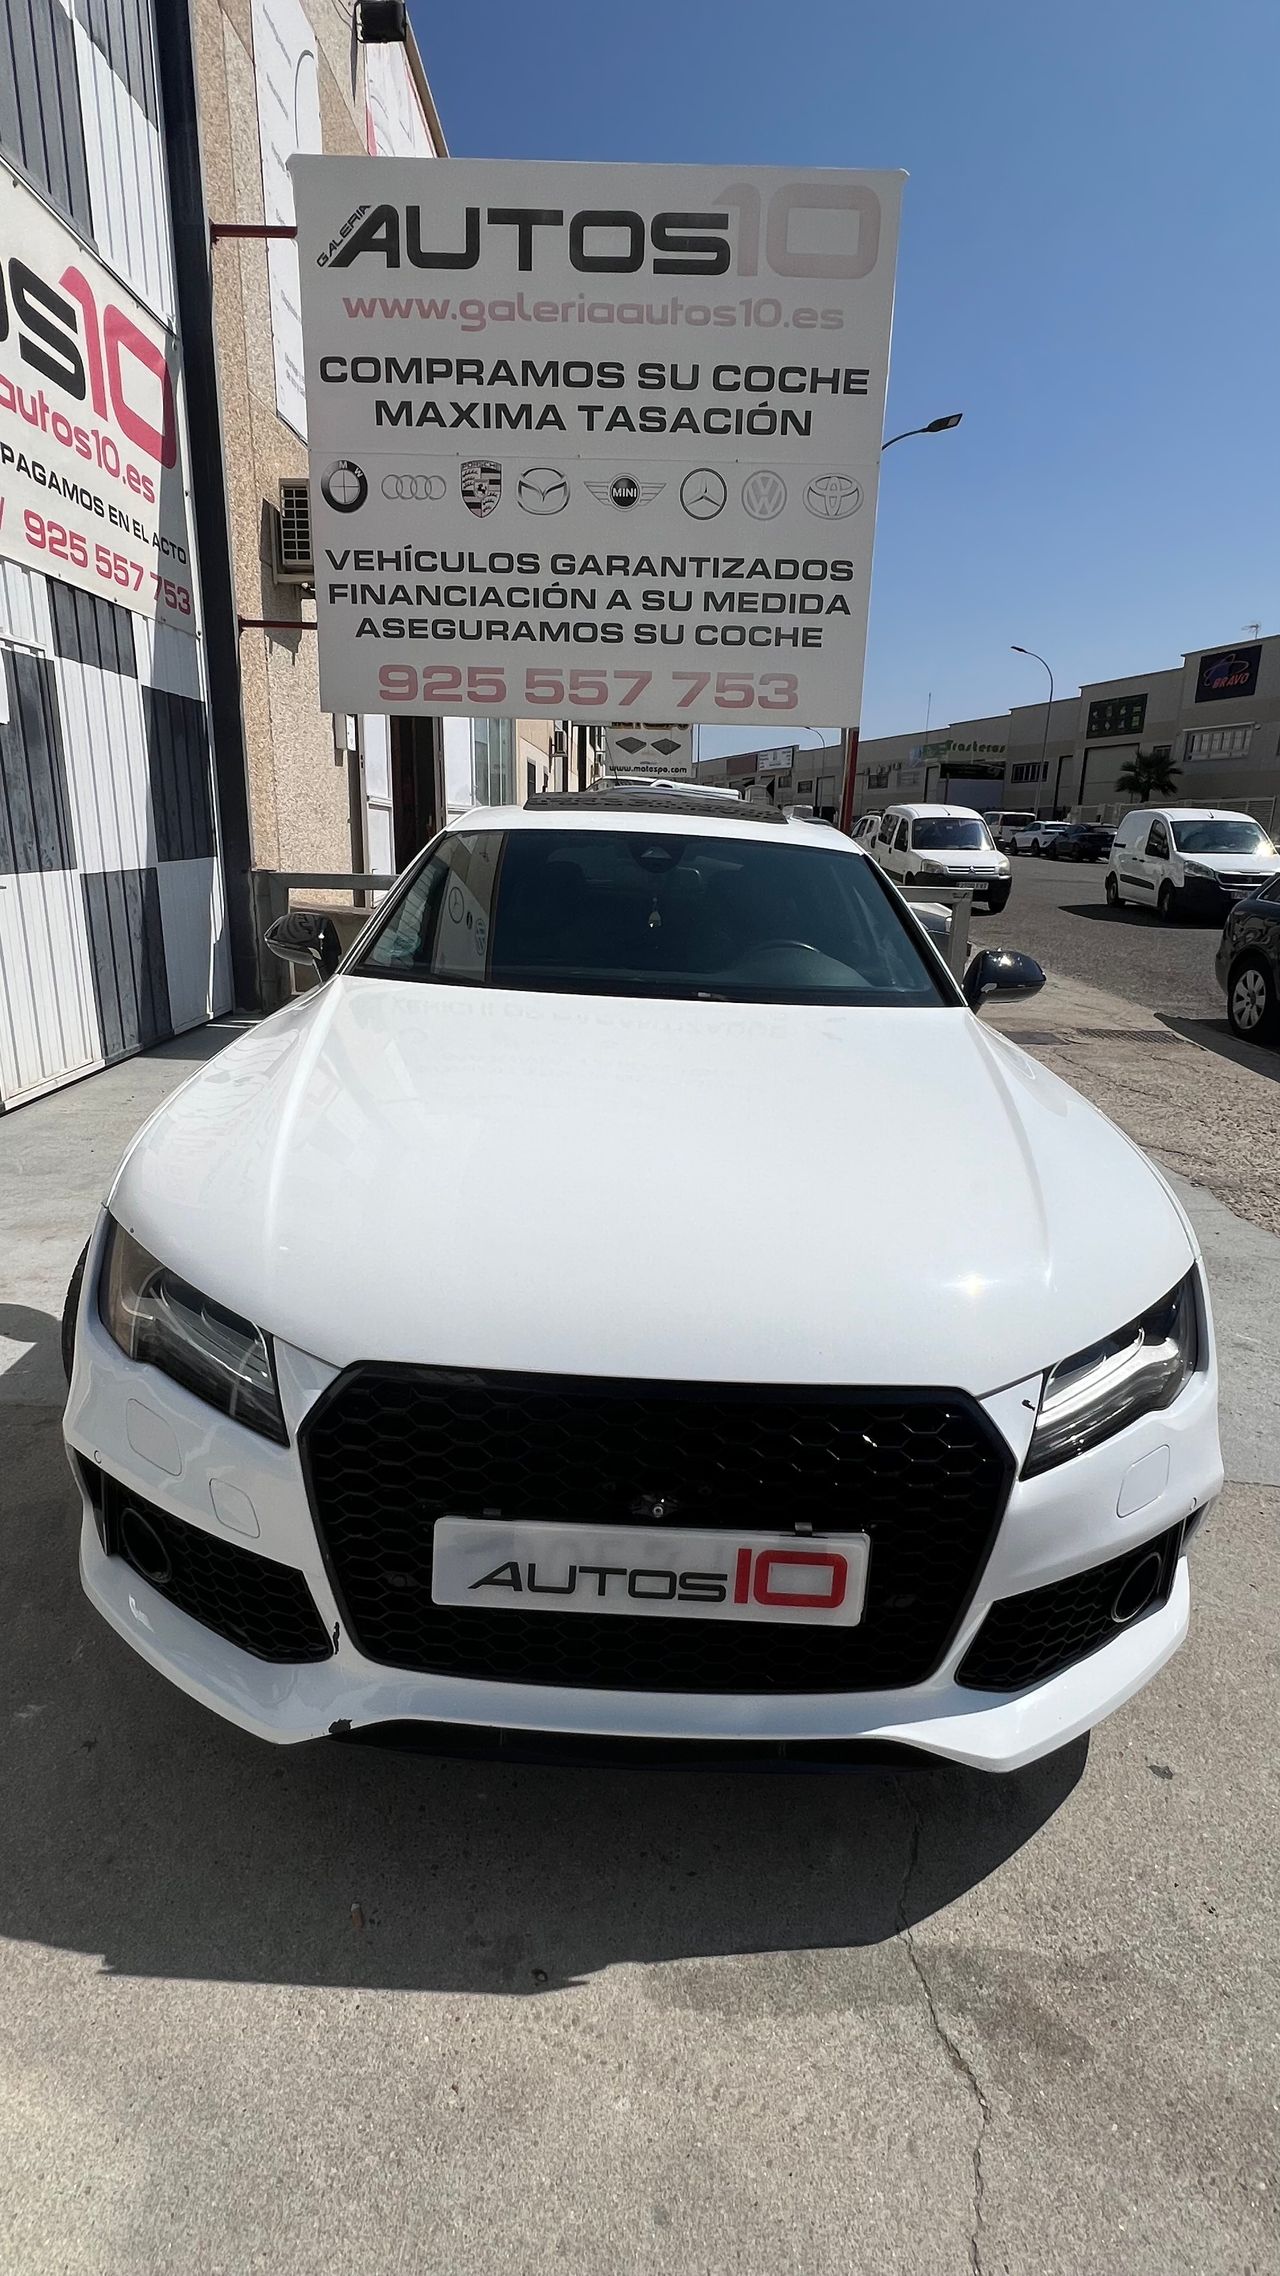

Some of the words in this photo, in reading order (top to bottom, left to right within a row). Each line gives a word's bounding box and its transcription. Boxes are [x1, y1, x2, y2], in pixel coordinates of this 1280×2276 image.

[316, 204, 371, 267] GALERIA
[342, 292, 844, 332] www.galeriaautos10.es
[0, 256, 177, 469] S10
[319, 355, 625, 389] COMPRAMOS
[637, 362, 700, 392] SU
[711, 364, 870, 396] COCHE
[375, 400, 567, 431] MAXIMA
[578, 401, 812, 436] TASACIÓN
[0, 441, 104, 518] PAGAMOS
[109, 503, 130, 537] EN
[133, 520, 150, 546] EL
[152, 531, 187, 565] ACTO
[612, 486, 638, 499] MINI
[24, 507, 89, 570] 925
[95, 547, 144, 592] 557
[150, 572, 191, 616] 753
[325, 544, 540, 574] VEHÍCULOS
[550, 553, 854, 582] GARANTIZADOS
[328, 581, 597, 610] FINANCIACIÓN
[606, 590, 632, 611] A
[641, 590, 694, 613] SU
[703, 591, 851, 615] MEDIDA
[355, 618, 624, 644] ASEGURAMOS
[633, 622, 685, 646] SU
[695, 623, 823, 648] COCHE
[378, 664, 507, 704] 925
[524, 668, 653, 707] 557
[671, 671, 799, 710] 753
[1212, 672, 1249, 689] BRAVO
